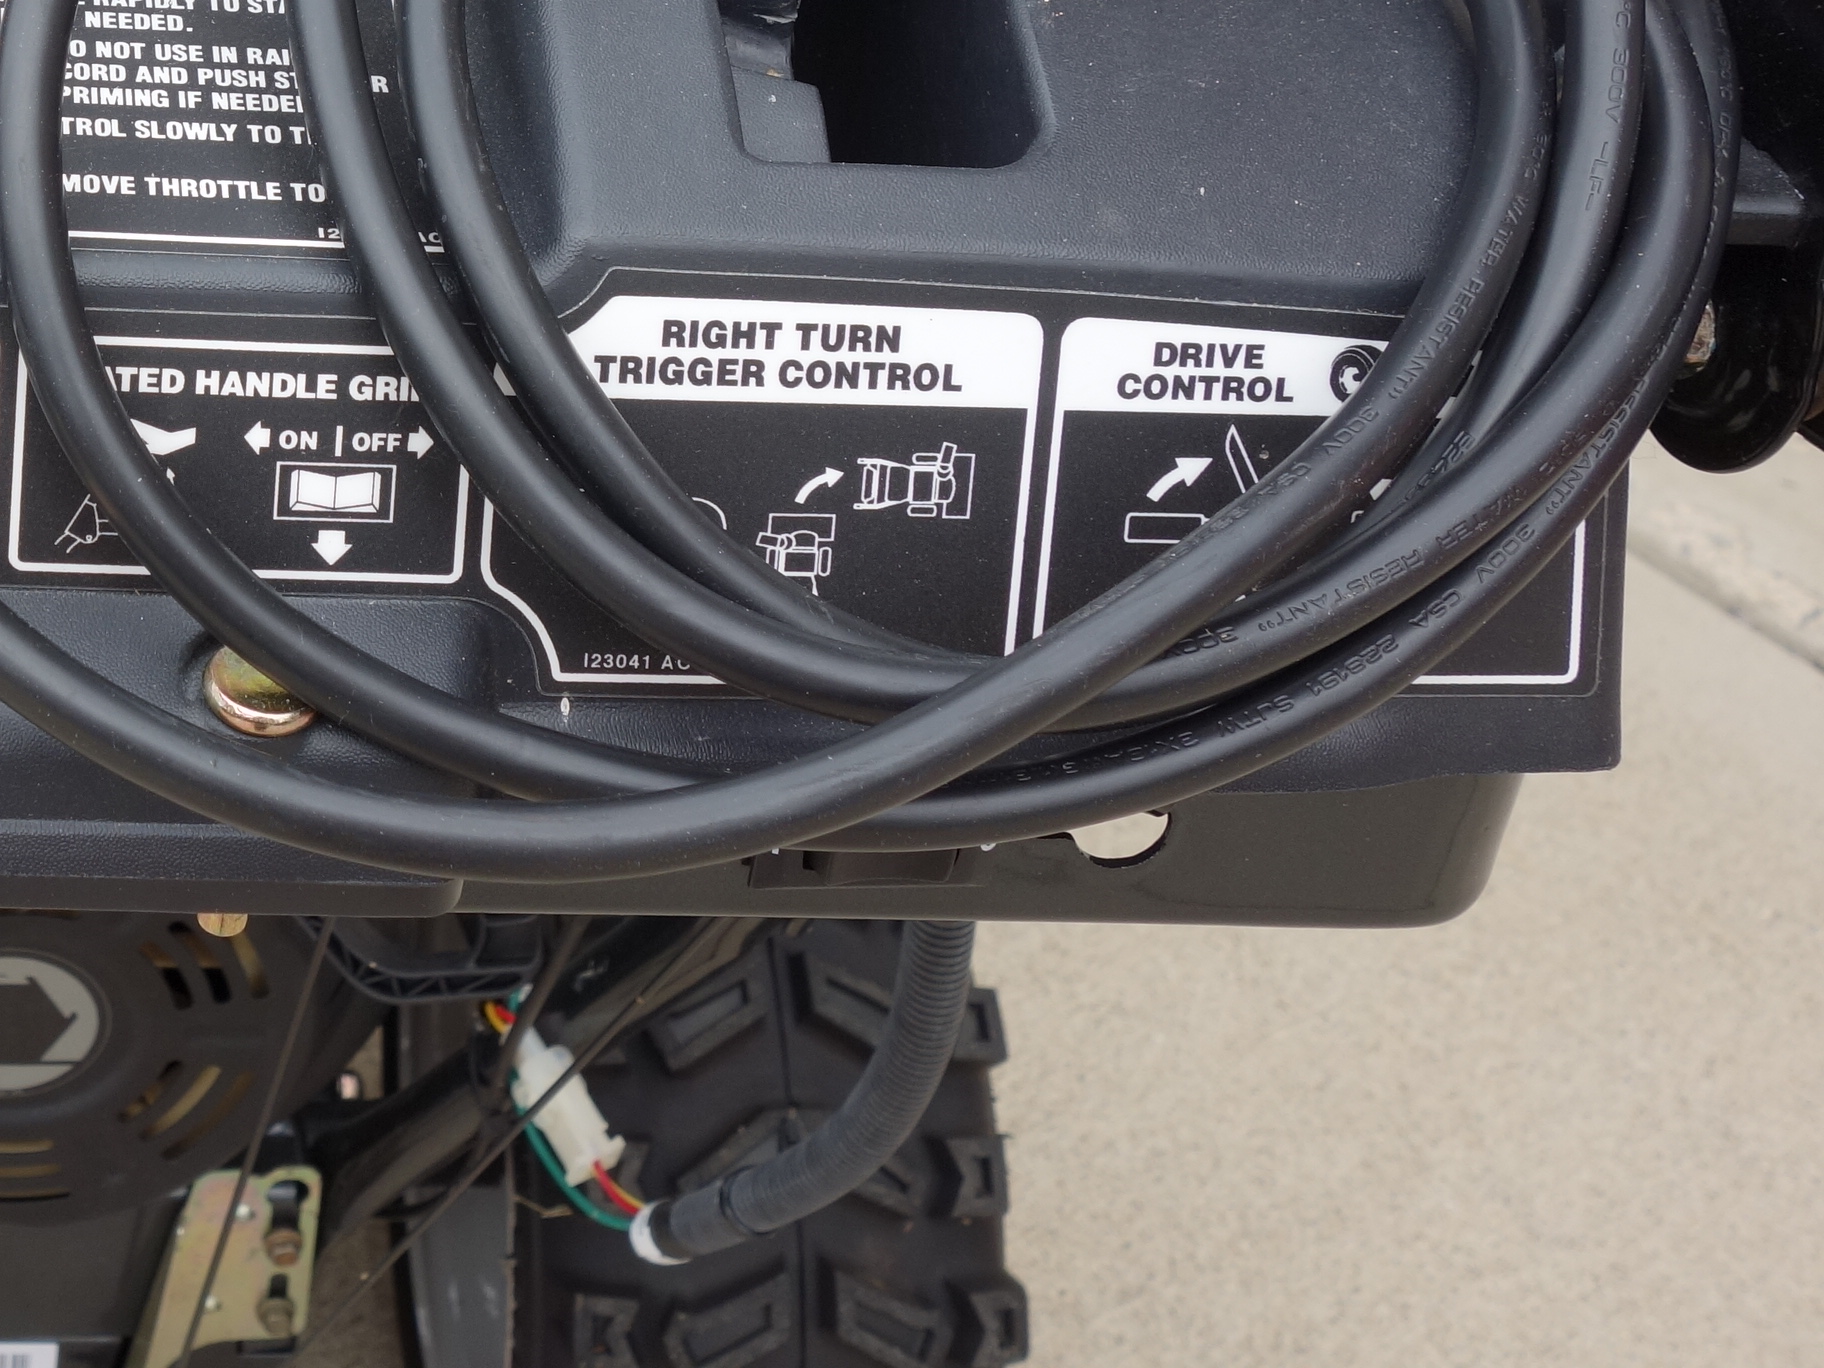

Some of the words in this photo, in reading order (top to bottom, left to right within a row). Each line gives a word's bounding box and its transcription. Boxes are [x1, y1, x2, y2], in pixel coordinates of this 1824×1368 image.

[84, 10, 194, 33] NEEDED.
[68, 39, 87, 59] O
[94, 40, 147, 61] NOT
[153, 43, 204, 64] USE
[212, 45, 238, 64] IN
[246, 47, 291, 67] RAI
[135, 64, 189, 86] AND
[198, 67, 266, 89] PUSH
[177, 89, 203, 110] IF
[211, 91, 304, 114] NEEDE
[61, 116, 127, 138] TROL
[134, 120, 238, 143] SLOWLY
[246, 123, 283, 144] TO
[143, 175, 283, 201] THROTTLE
[290, 181, 327, 203] TO
[661, 318, 783, 352] RIGHT
[794, 322, 902, 354] TURN
[1153, 341, 1267, 370] DRIVE
[105, 365, 185, 395] TED
[195, 369, 338, 401] HANDLE
[348, 374, 420, 402] GRI
[593, 354, 765, 388] TRIGGER
[776, 358, 964, 393] CONTROL
[1116, 372, 1295, 404] CONTROL
[278, 429, 318, 451] ON
[351, 432, 403, 453] OFF
[1407, 585, 1465, 629] CSA
